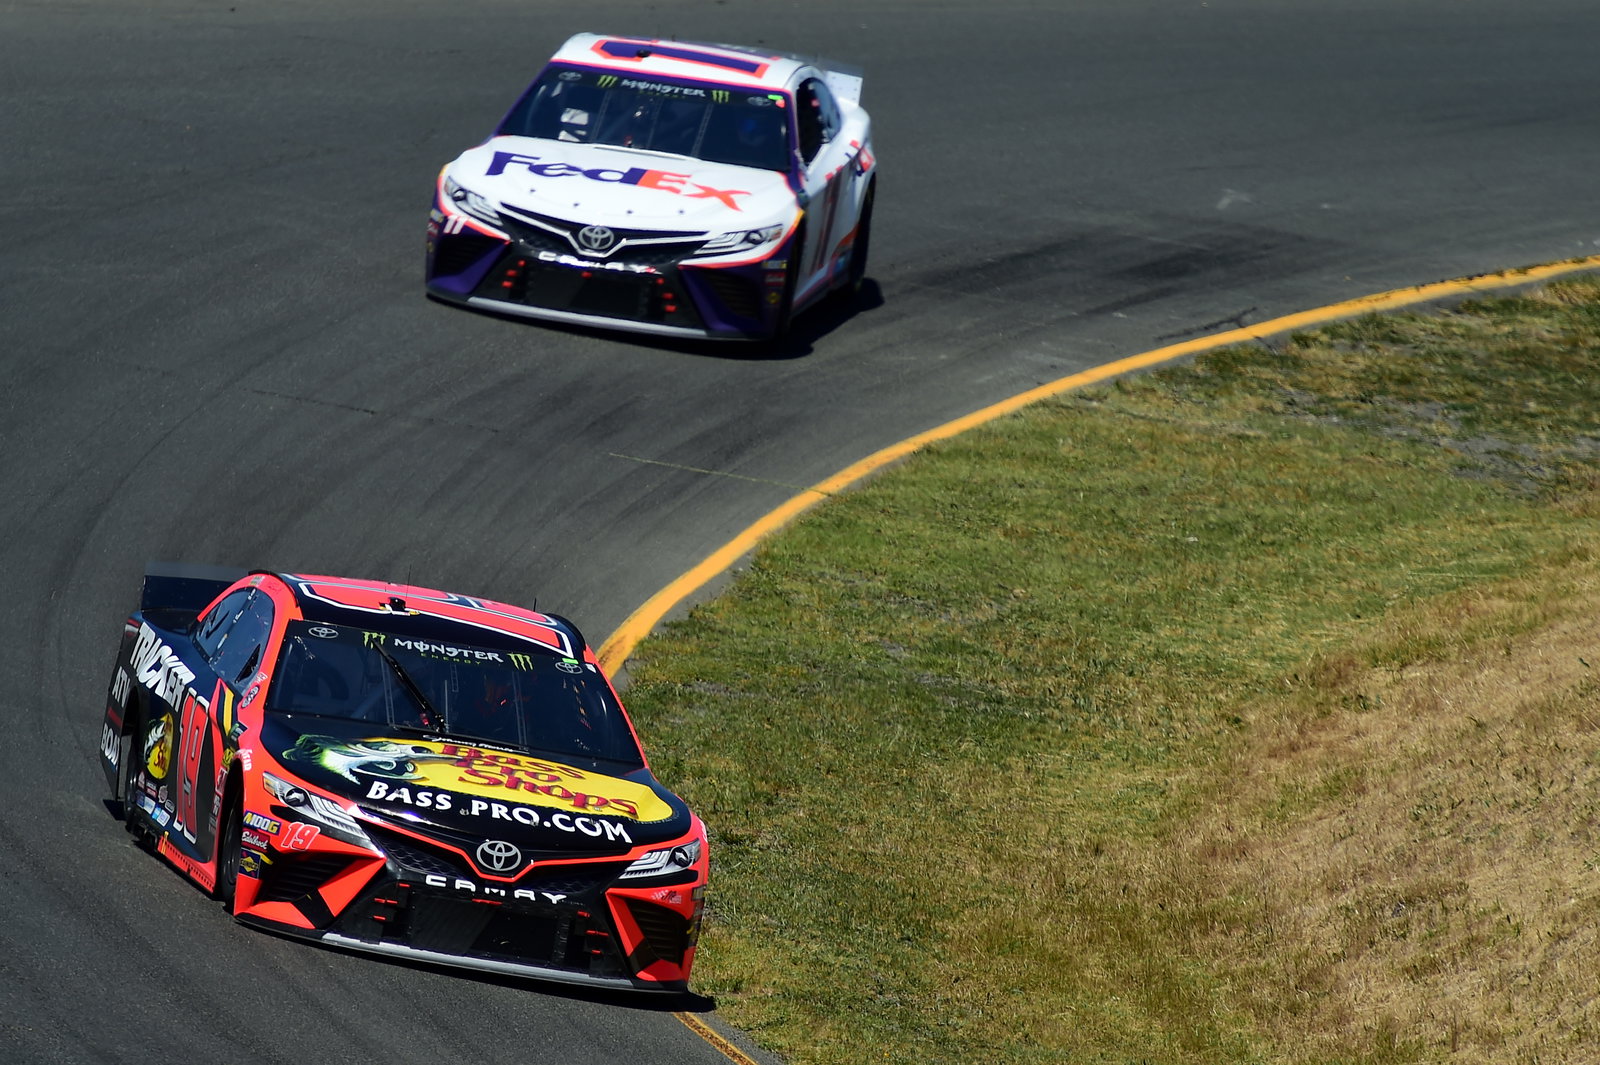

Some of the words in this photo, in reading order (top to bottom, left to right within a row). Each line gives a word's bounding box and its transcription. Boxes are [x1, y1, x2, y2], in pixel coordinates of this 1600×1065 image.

[620, 78, 706, 98] MONSTER
[486, 150, 752, 212] FedEx
[394, 637, 504, 663] MONSTER
[111, 666, 131, 708] ATV
[440, 743, 586, 780] Bass
[366, 780, 453, 811] BASS
[457, 768, 640, 816] Shops
[280, 821, 321, 851] 19
[425, 873, 567, 905] CAMRY
